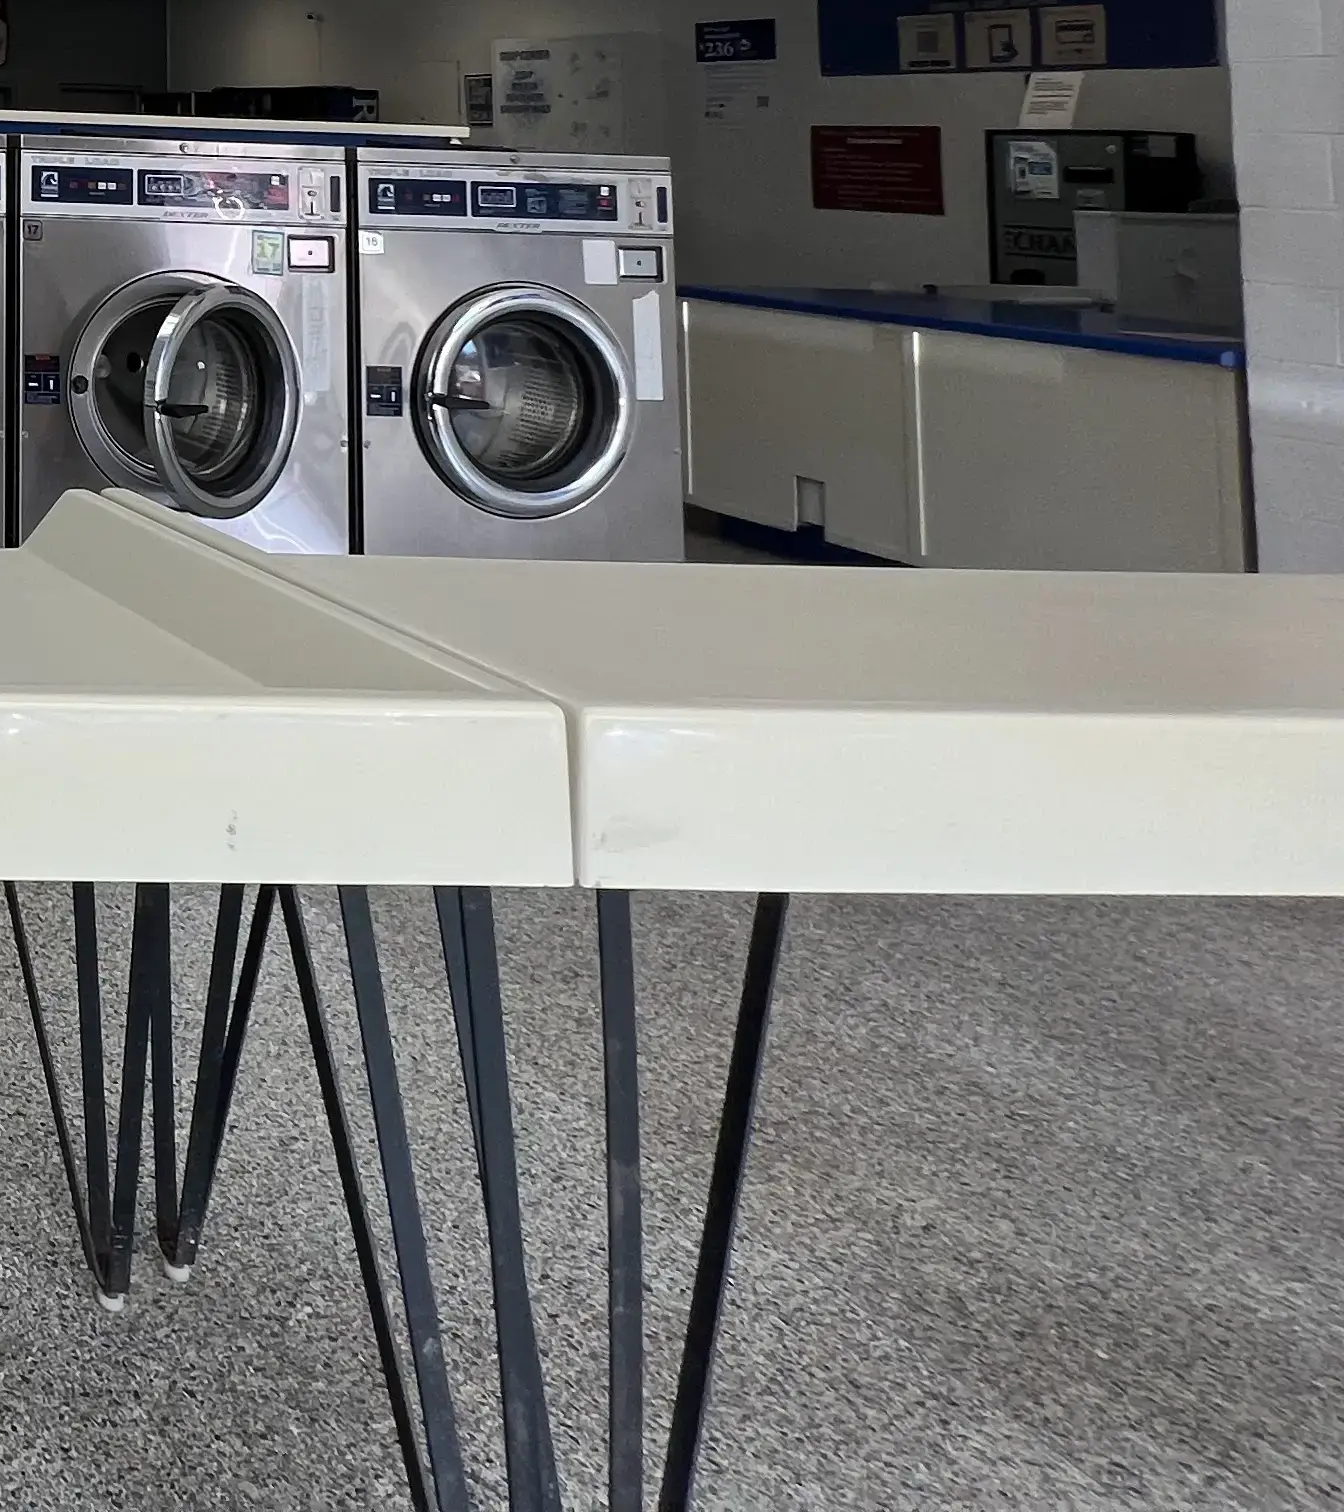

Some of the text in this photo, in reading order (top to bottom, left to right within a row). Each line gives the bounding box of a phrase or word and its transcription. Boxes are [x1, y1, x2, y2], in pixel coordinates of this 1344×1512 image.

[163, 210, 208, 219] DEXTER
[27, 224, 39, 236] 17
[496, 222, 541, 231] DEXTER
[256, 241, 281, 259] 17
